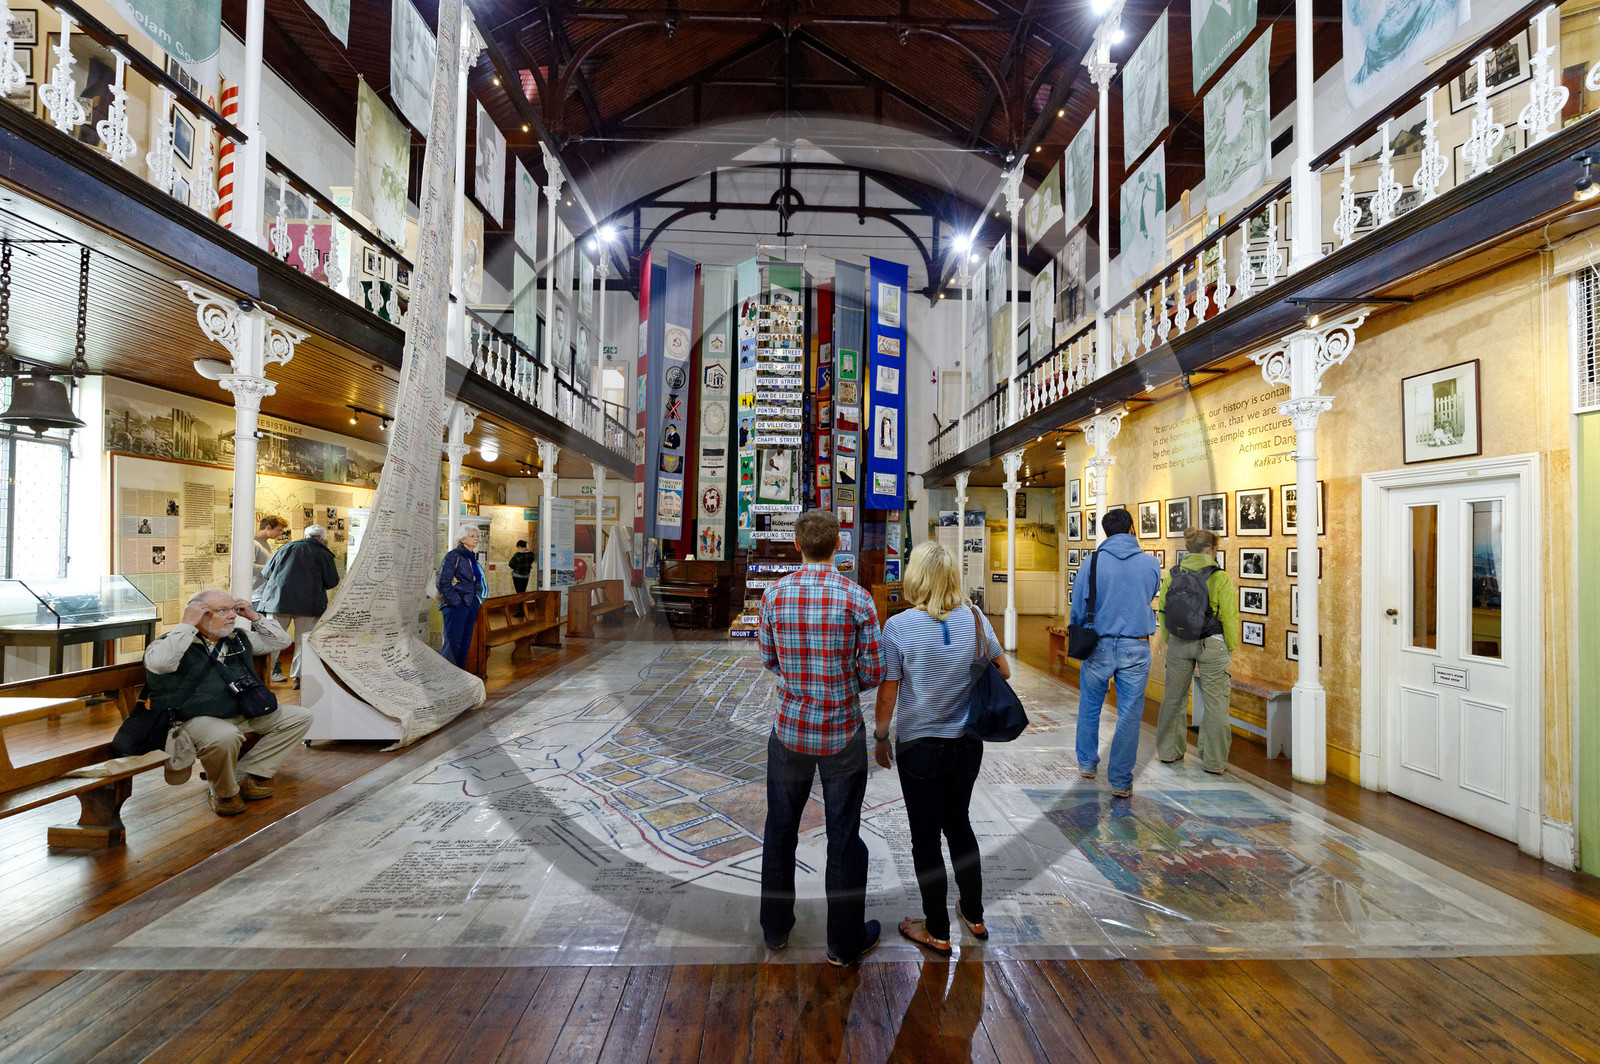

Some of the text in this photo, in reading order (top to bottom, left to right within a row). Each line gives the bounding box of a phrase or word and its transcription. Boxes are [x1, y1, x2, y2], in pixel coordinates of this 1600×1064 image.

[1160, 436, 1169, 445] the
[1228, 415, 1244, 426] that
[1247, 412, 1260, 420] we
[1262, 406, 1276, 416] are
[1161, 422, 1179, 432] struck
[1208, 408, 1222, 418] our
[1223, 400, 1250, 414] history
[1252, 396, 1258, 404] is
[1153, 450, 1160, 460] by
[1160, 448, 1170, 456] the
[1220, 428, 1245, 442] simple
[1248, 418, 1292, 436] structures
[1239, 435, 1297, 454] Achmat Dang
[1153, 462, 1168, 470] resist
[1254, 456, 1282, 468] Kafka's
